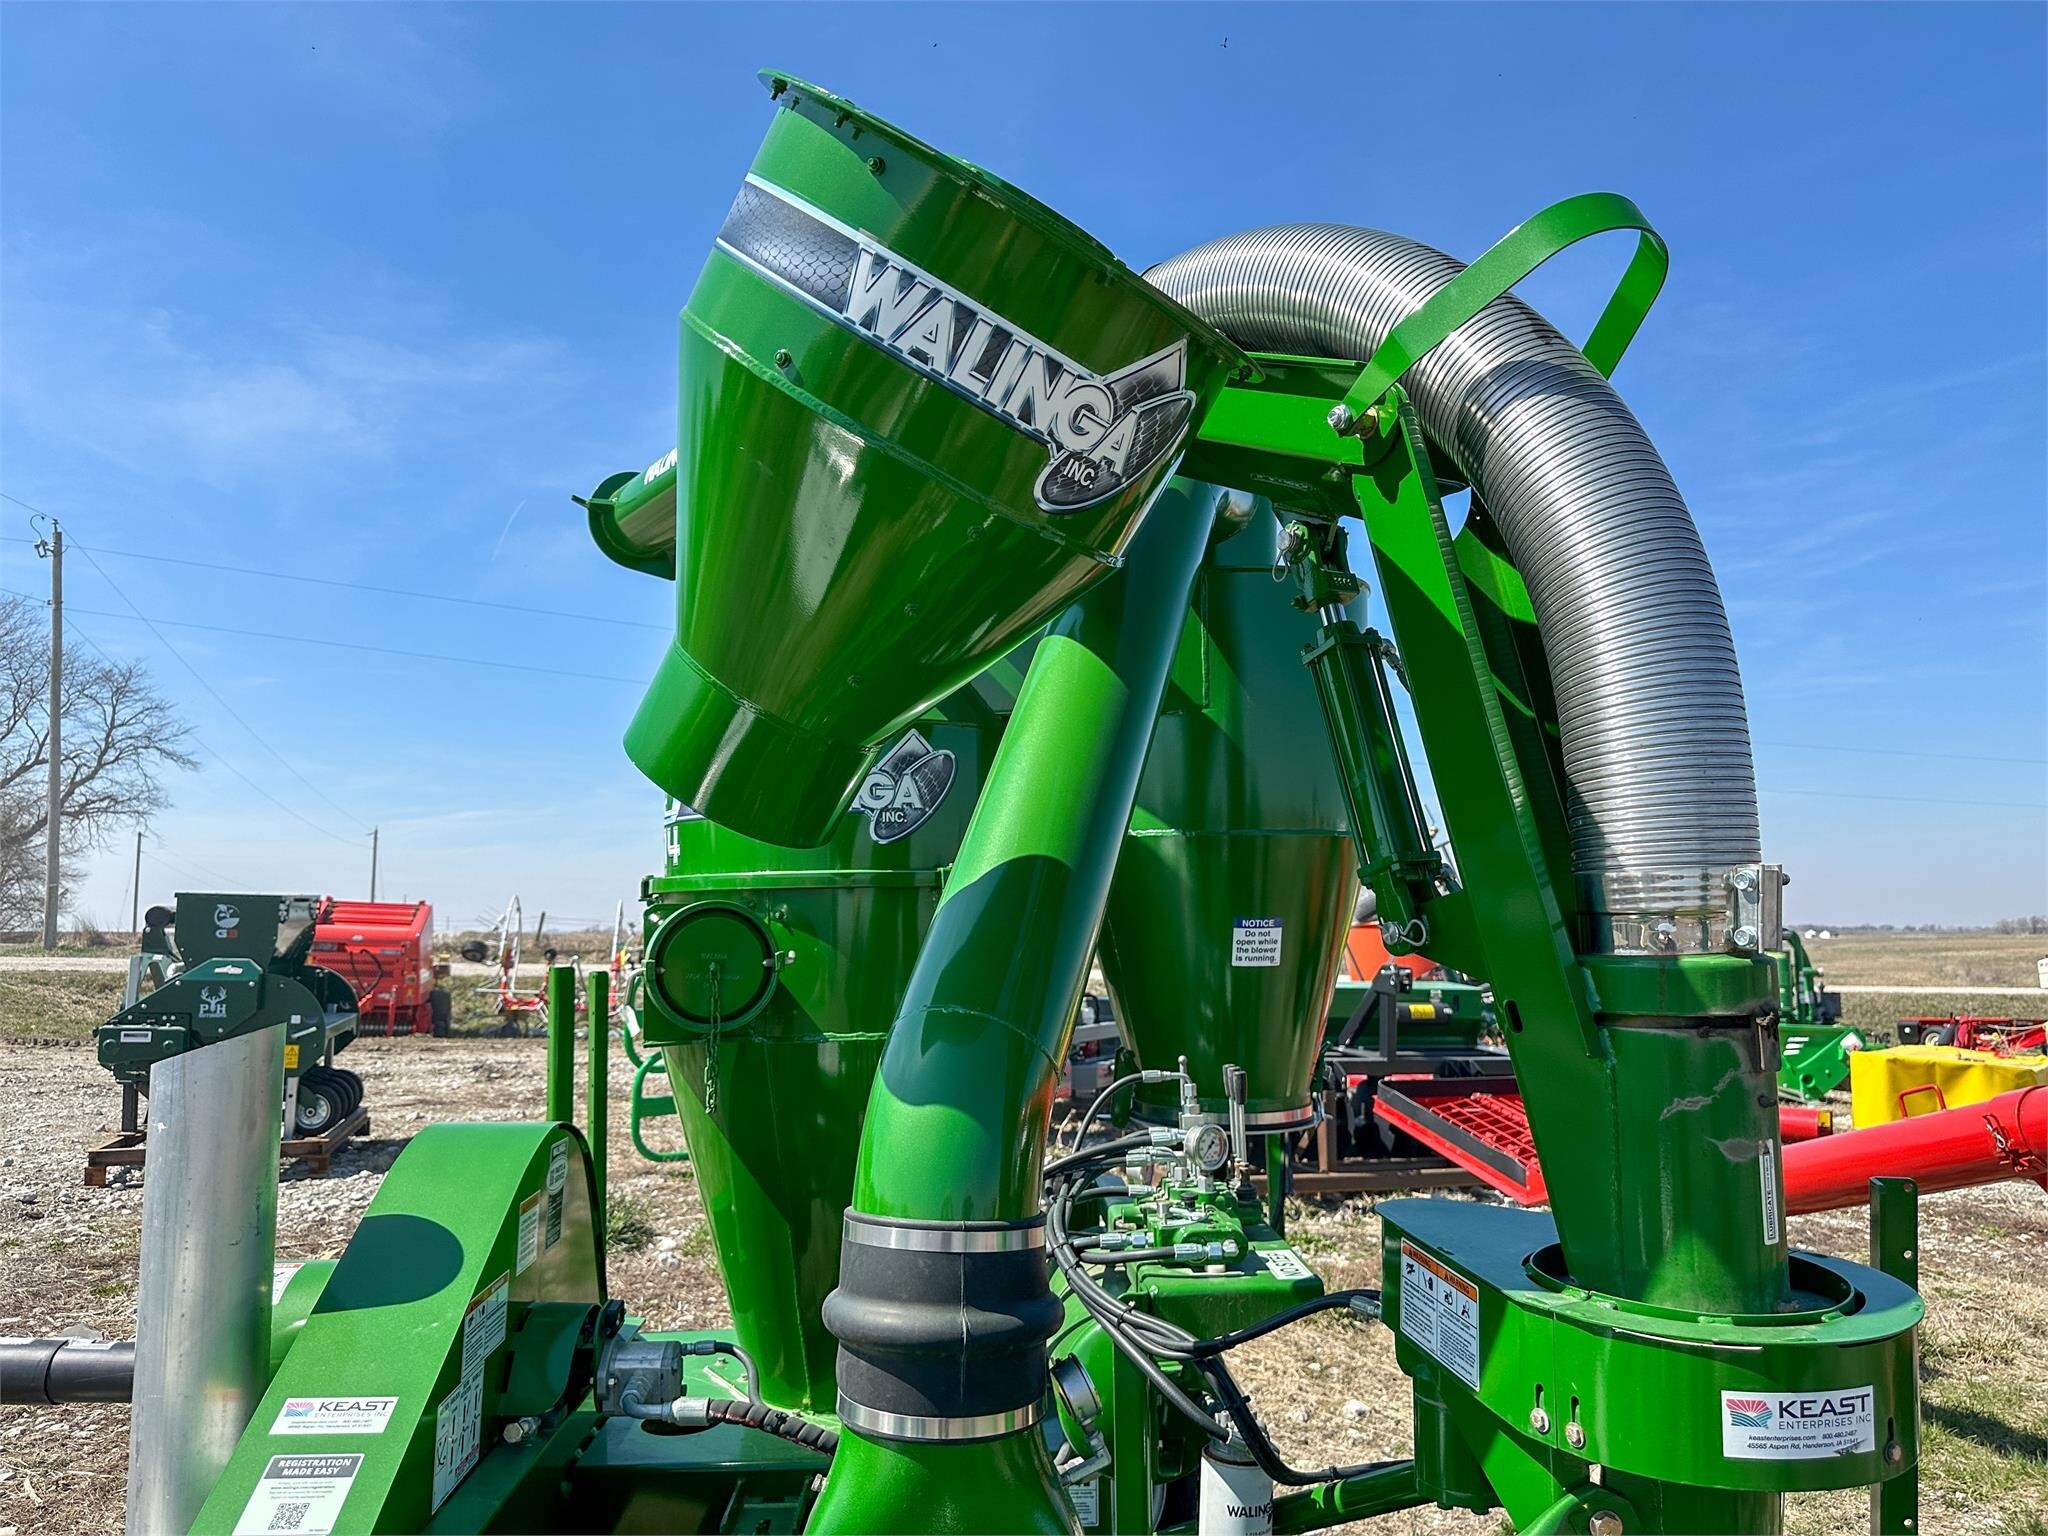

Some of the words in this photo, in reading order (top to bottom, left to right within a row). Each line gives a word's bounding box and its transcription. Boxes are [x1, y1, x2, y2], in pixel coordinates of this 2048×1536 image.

[845, 246, 1139, 475] WALINGA
[1064, 459, 1095, 489] INC.
[882, 811, 908, 823] INC.
[1242, 919, 1275, 927] NOTICE
[1245, 955, 1277, 963] running.
[318, 1401, 394, 1412] KEAST
[1779, 1393, 1871, 1419] KEAST
[1779, 1417, 1852, 1430] ENTERPRISES
[1856, 1413, 1872, 1423] INC
[1769, 1442, 1788, 1451] Aspen
[278, 1458, 352, 1467] REGISTRATION
[282, 1467, 313, 1476] MADE
[314, 1466, 340, 1475] EASY
